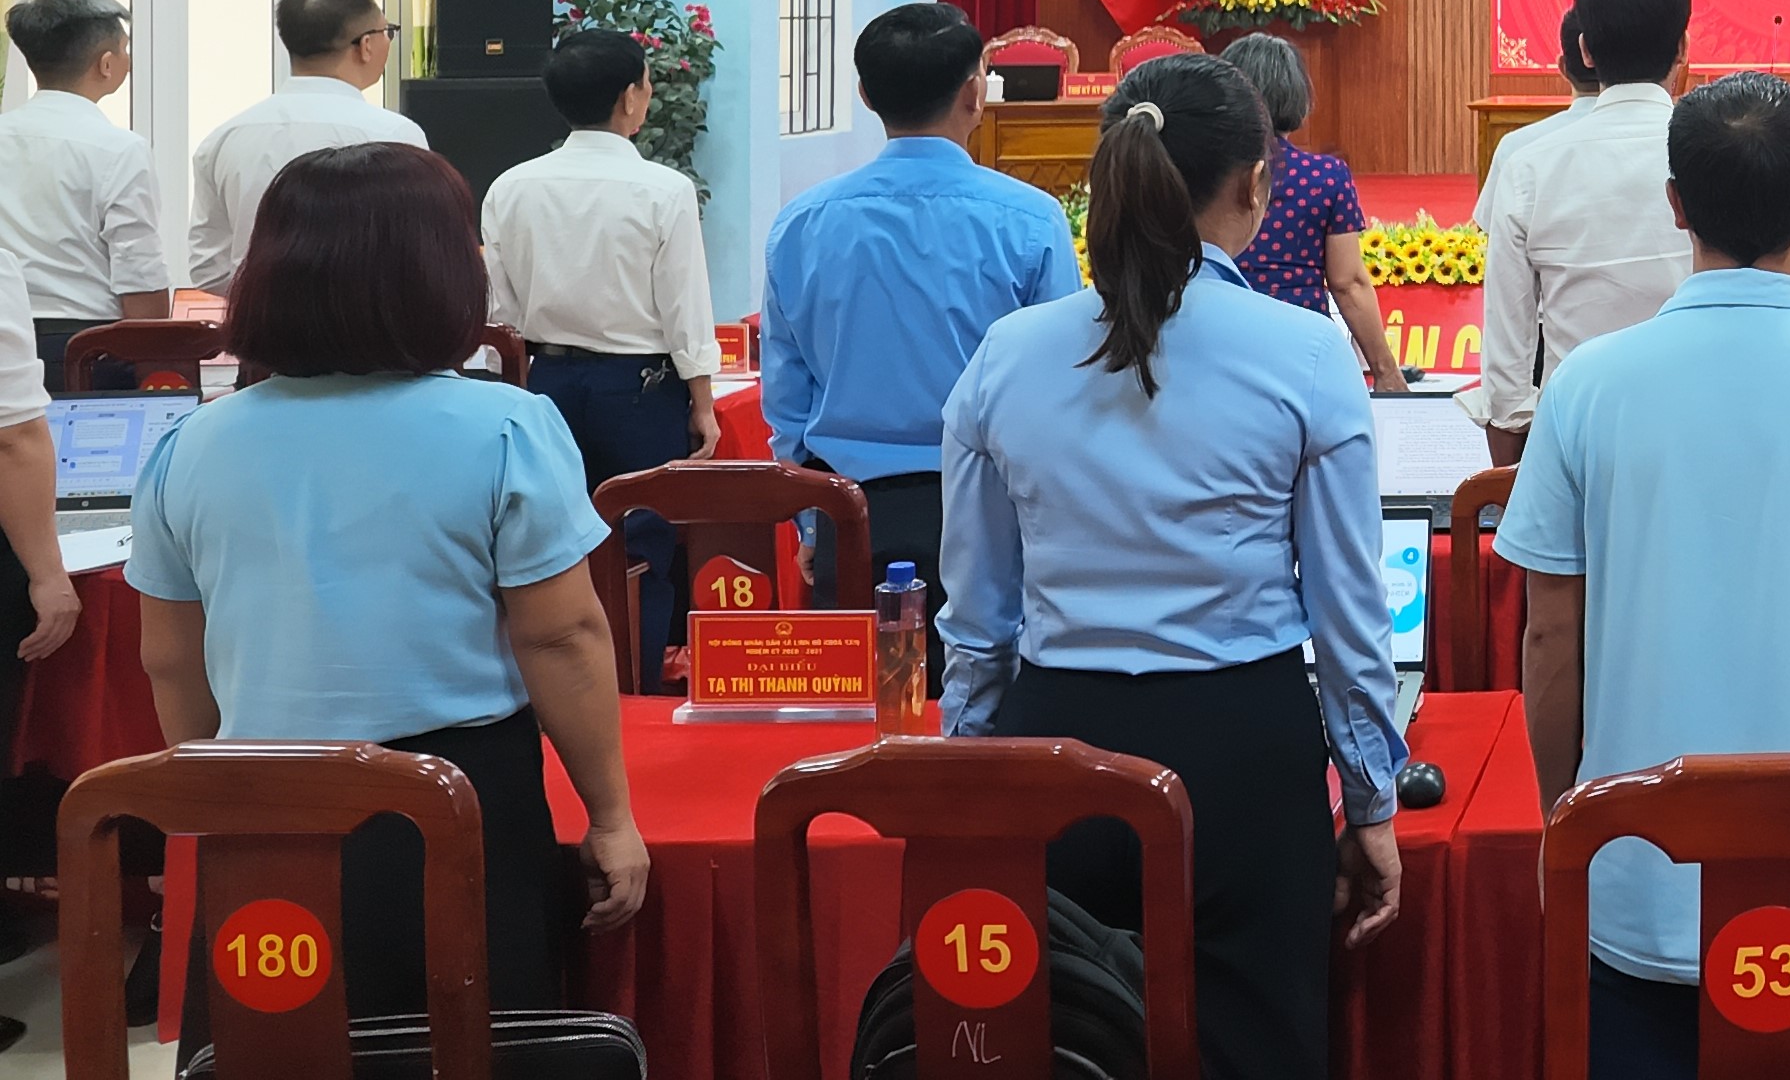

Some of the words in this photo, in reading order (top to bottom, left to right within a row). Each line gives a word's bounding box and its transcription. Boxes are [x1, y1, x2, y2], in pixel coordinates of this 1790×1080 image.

[1407, 552, 1414, 560] 4
[711, 576, 754, 608] 18
[708, 678, 726, 696] TẠ
[731, 678, 753, 696] THỊ
[758, 678, 807, 692] THANH
[812, 674, 862, 693] QUỲNH
[227, 933, 318, 978] 180
[944, 923, 1011, 973] 15
